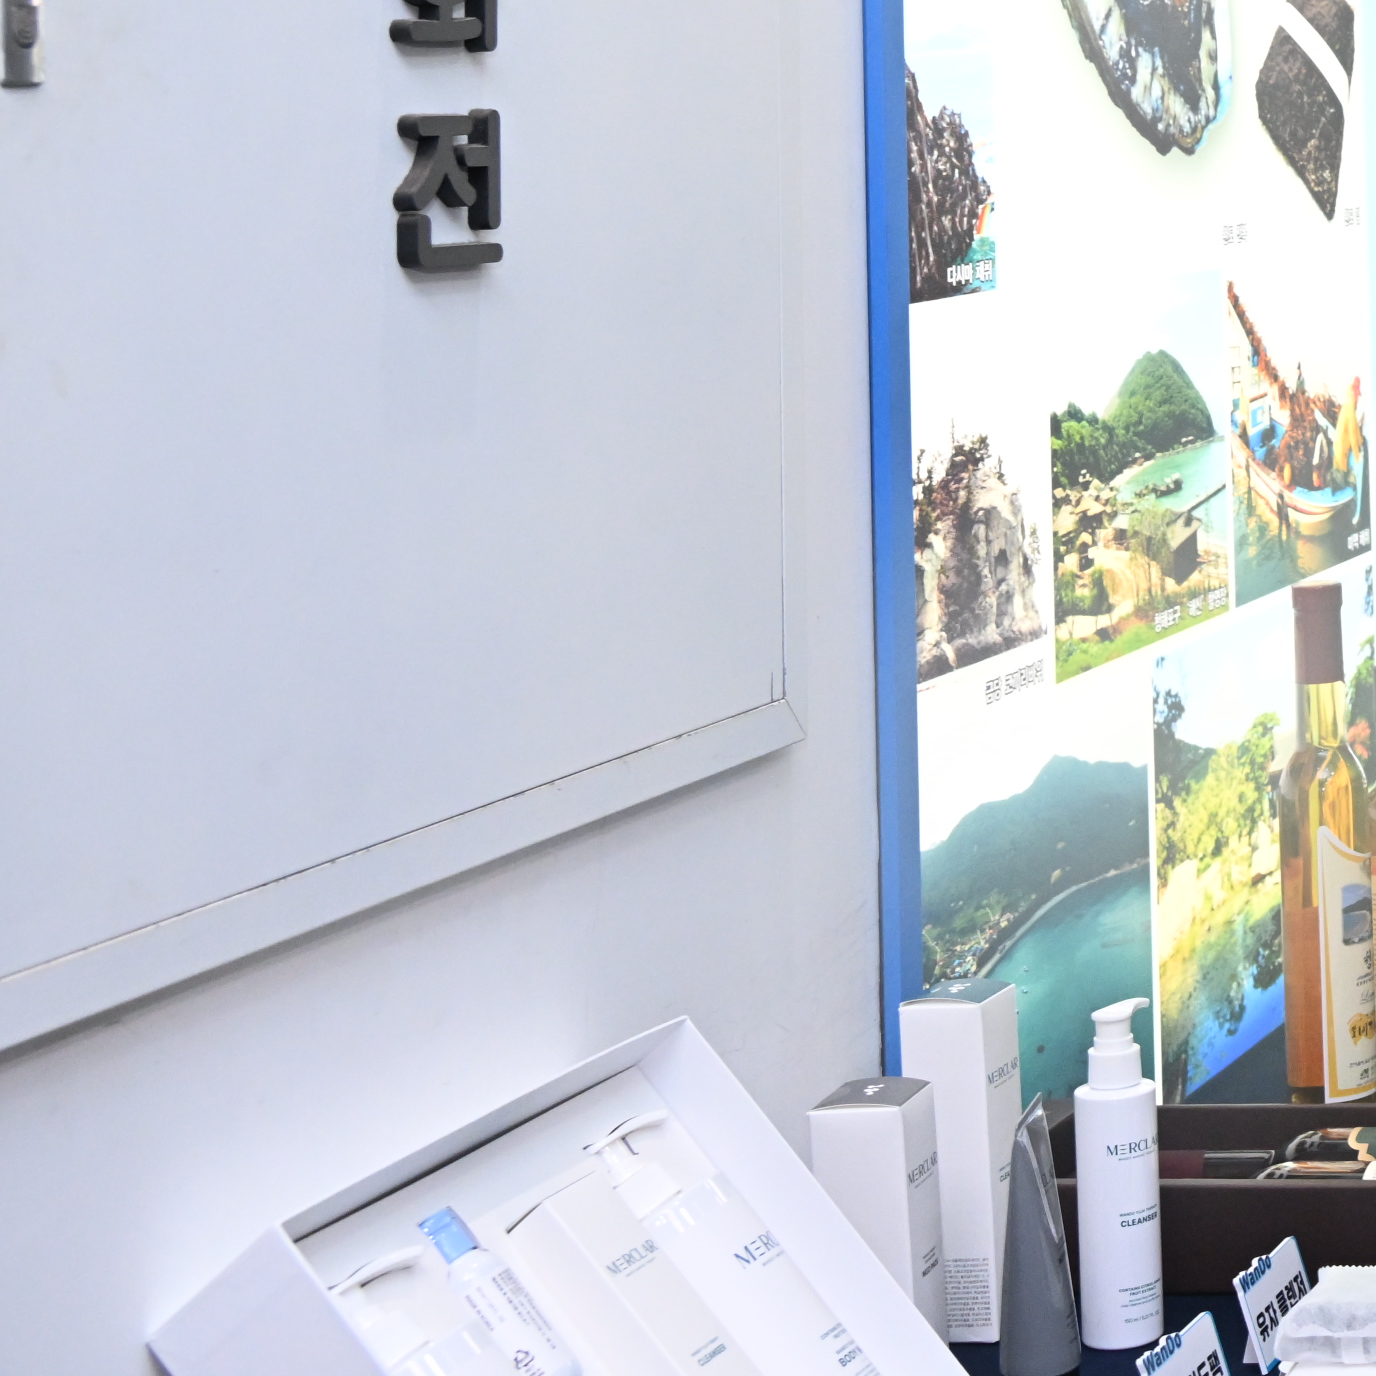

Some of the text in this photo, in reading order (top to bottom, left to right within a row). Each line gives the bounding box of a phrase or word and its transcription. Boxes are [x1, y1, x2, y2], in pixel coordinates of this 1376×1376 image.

[947, 259, 993, 286] 다시마 채취
[987, 1056, 1019, 1085] MERCLAR
[1106, 1134, 1160, 1158] MERCLA
[1120, 1211, 1158, 1228] CLEANSER
[605, 1238, 659, 1276] MERCLAR
[733, 1231, 781, 1270] MERC
[1239, 1254, 1273, 1295] WanDo
[1255, 1300, 1281, 1343] 유자
[1142, 1332, 1182, 1376] WanDo
